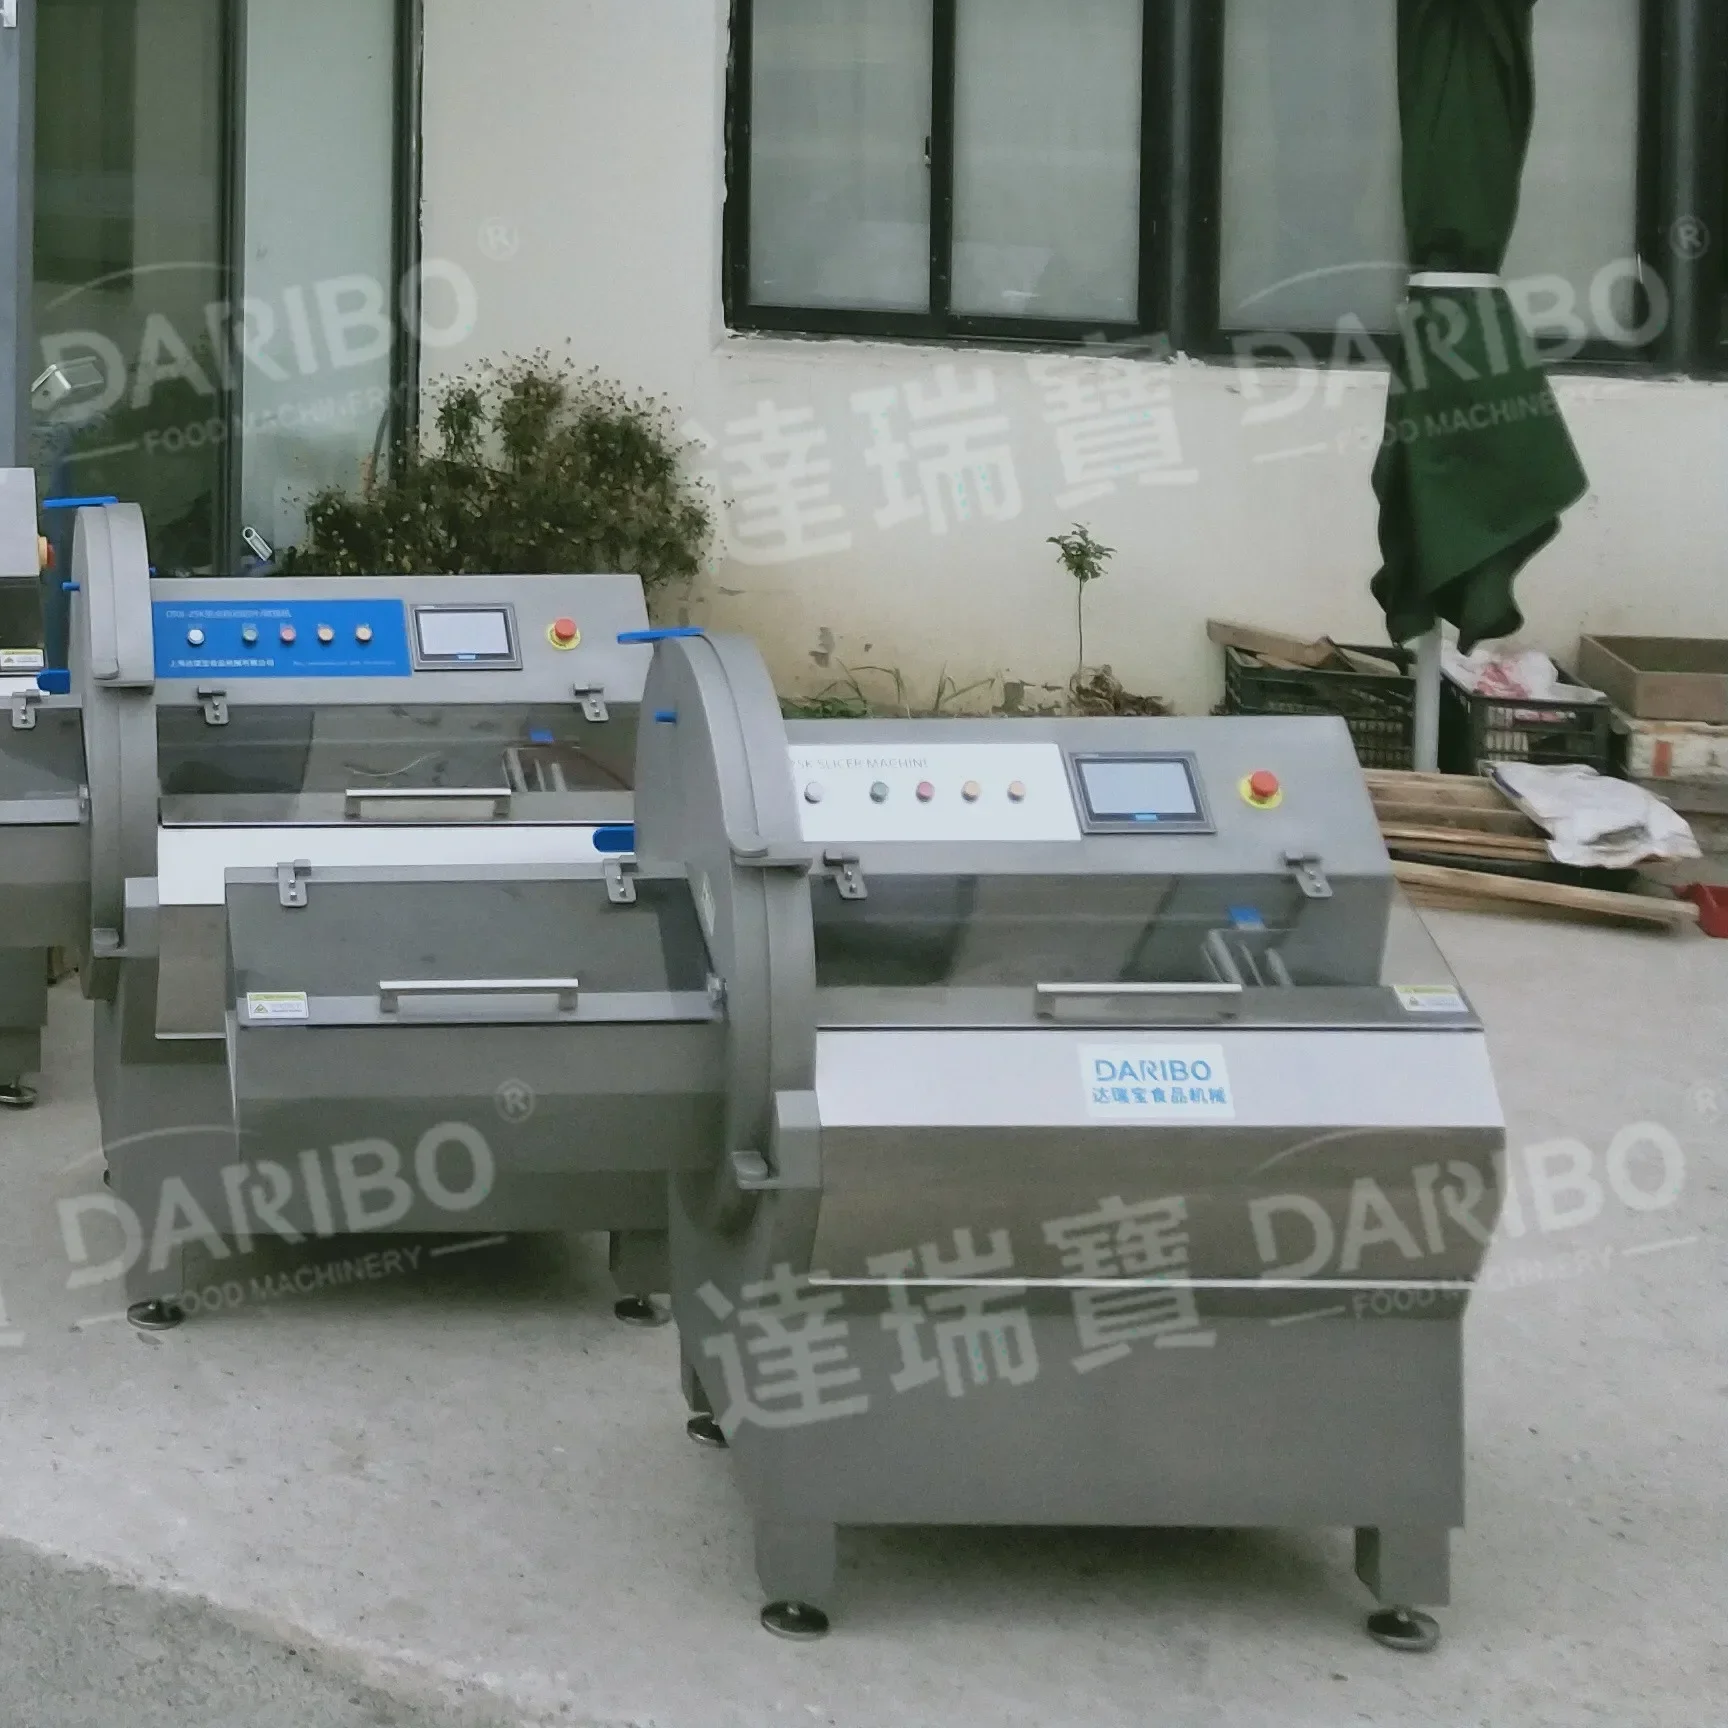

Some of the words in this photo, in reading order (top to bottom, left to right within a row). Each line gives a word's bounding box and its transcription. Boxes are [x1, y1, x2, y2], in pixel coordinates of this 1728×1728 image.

[1094, 1059, 1212, 1082] DARIBO
[1091, 1086, 1228, 1105] 达瑞宝食品机械
